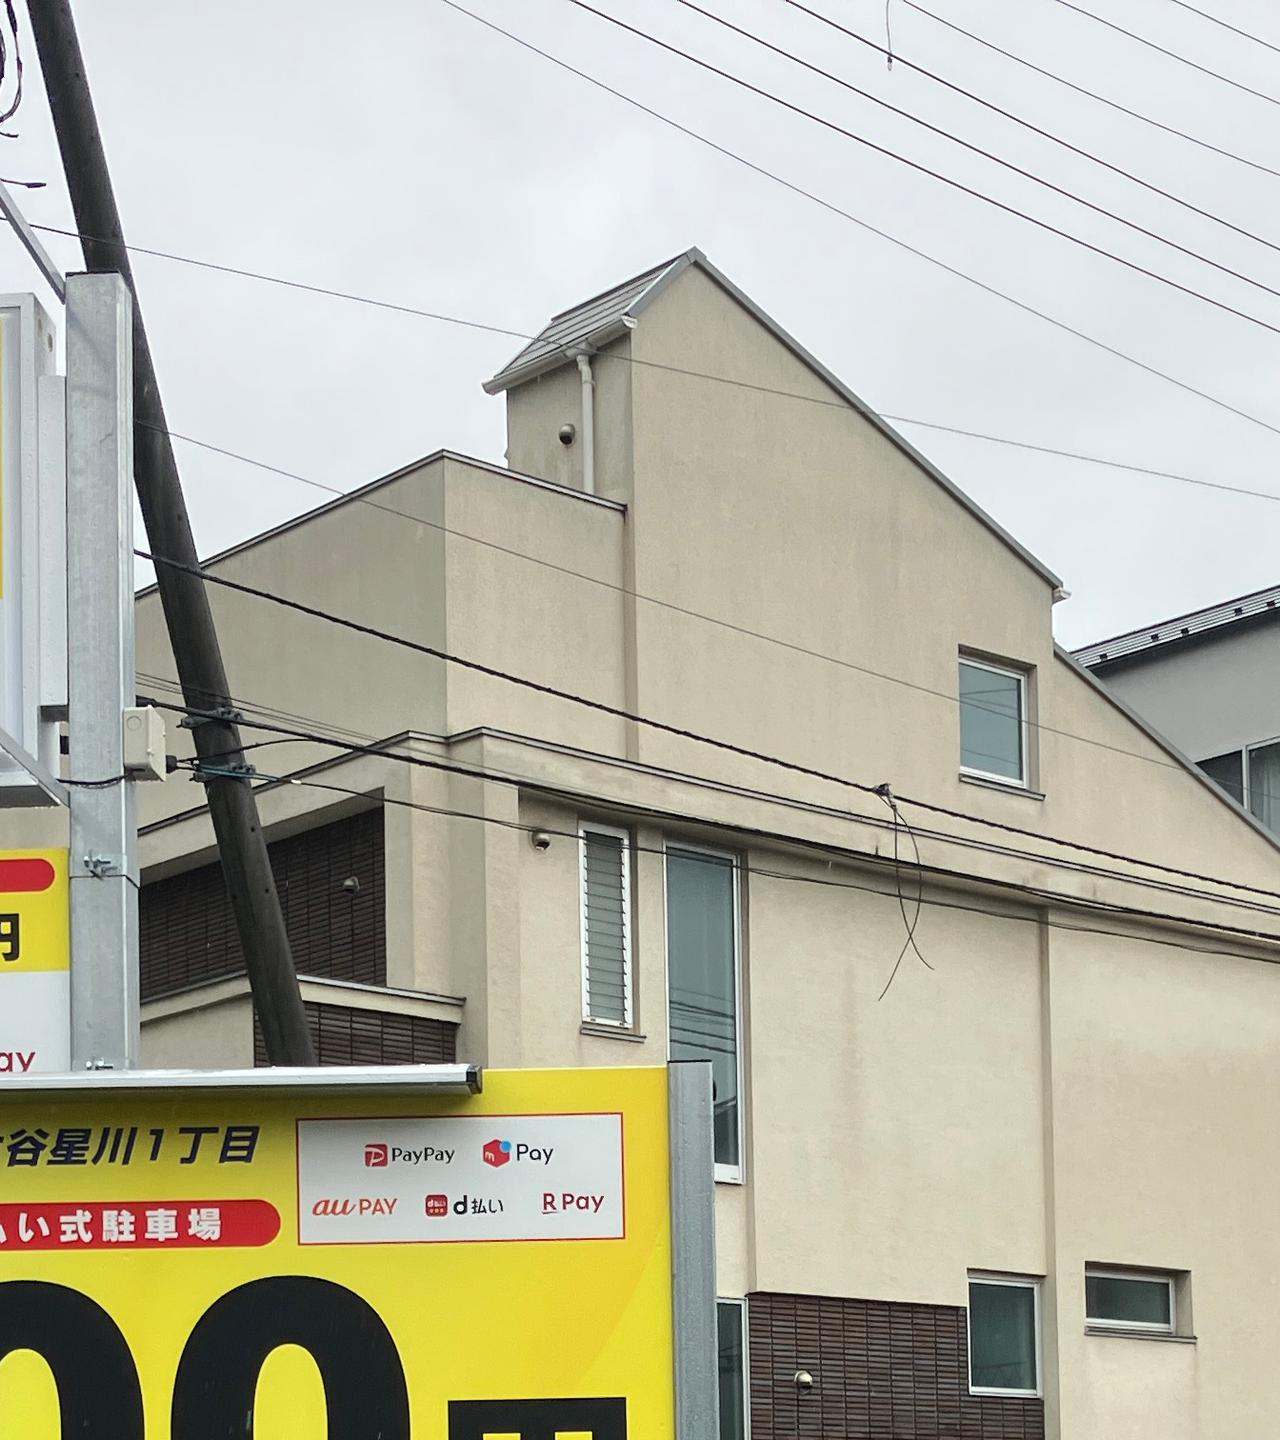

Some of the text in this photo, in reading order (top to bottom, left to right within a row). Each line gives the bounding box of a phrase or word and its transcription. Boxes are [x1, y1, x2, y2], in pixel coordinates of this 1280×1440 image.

[391, 1146, 456, 1165] PayPay
[516, 1143, 554, 1165] Pay
[360, 1198, 398, 1216] PAY
[453, 1194, 504, 1216] d払い
[563, 1193, 605, 1214] Pay
